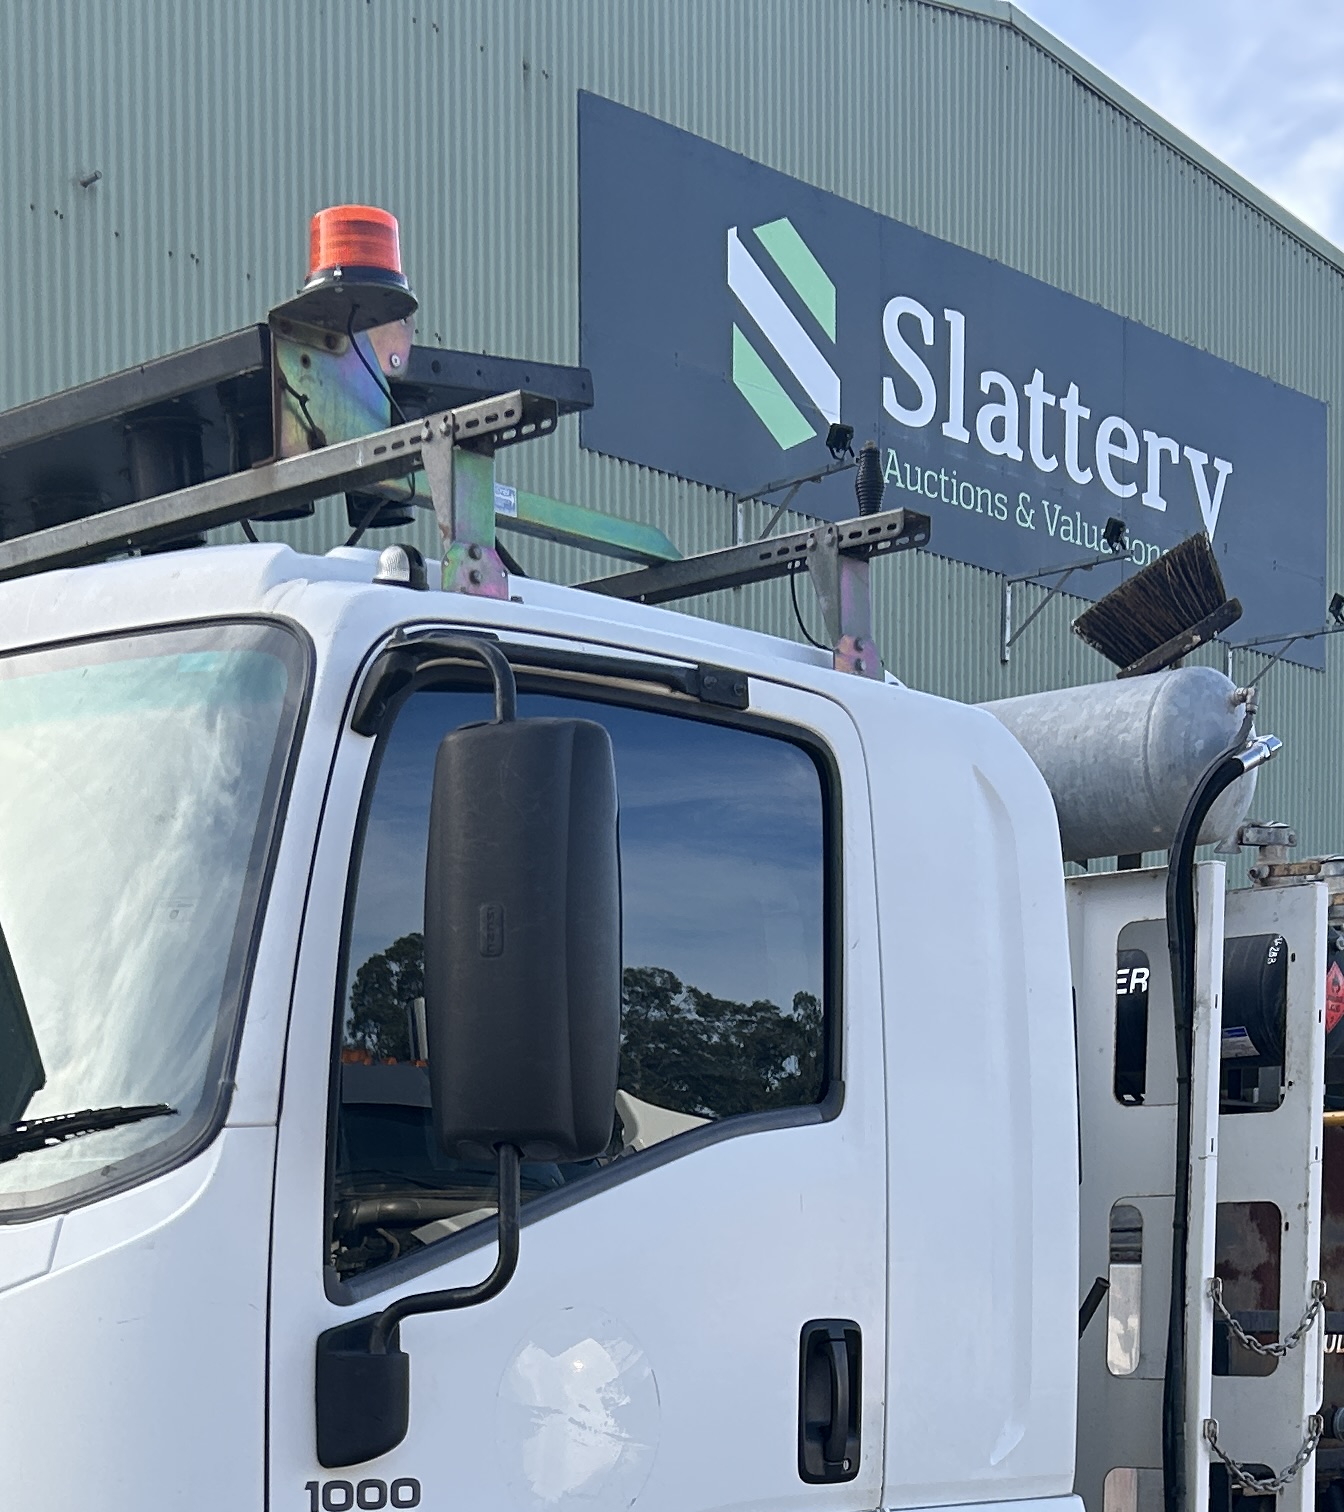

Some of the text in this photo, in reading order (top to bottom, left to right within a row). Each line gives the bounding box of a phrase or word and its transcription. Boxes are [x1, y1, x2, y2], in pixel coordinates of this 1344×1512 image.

[882, 295, 1234, 545] Slattery
[883, 448, 1008, 522] Auctions
[1015, 491, 1037, 531] &
